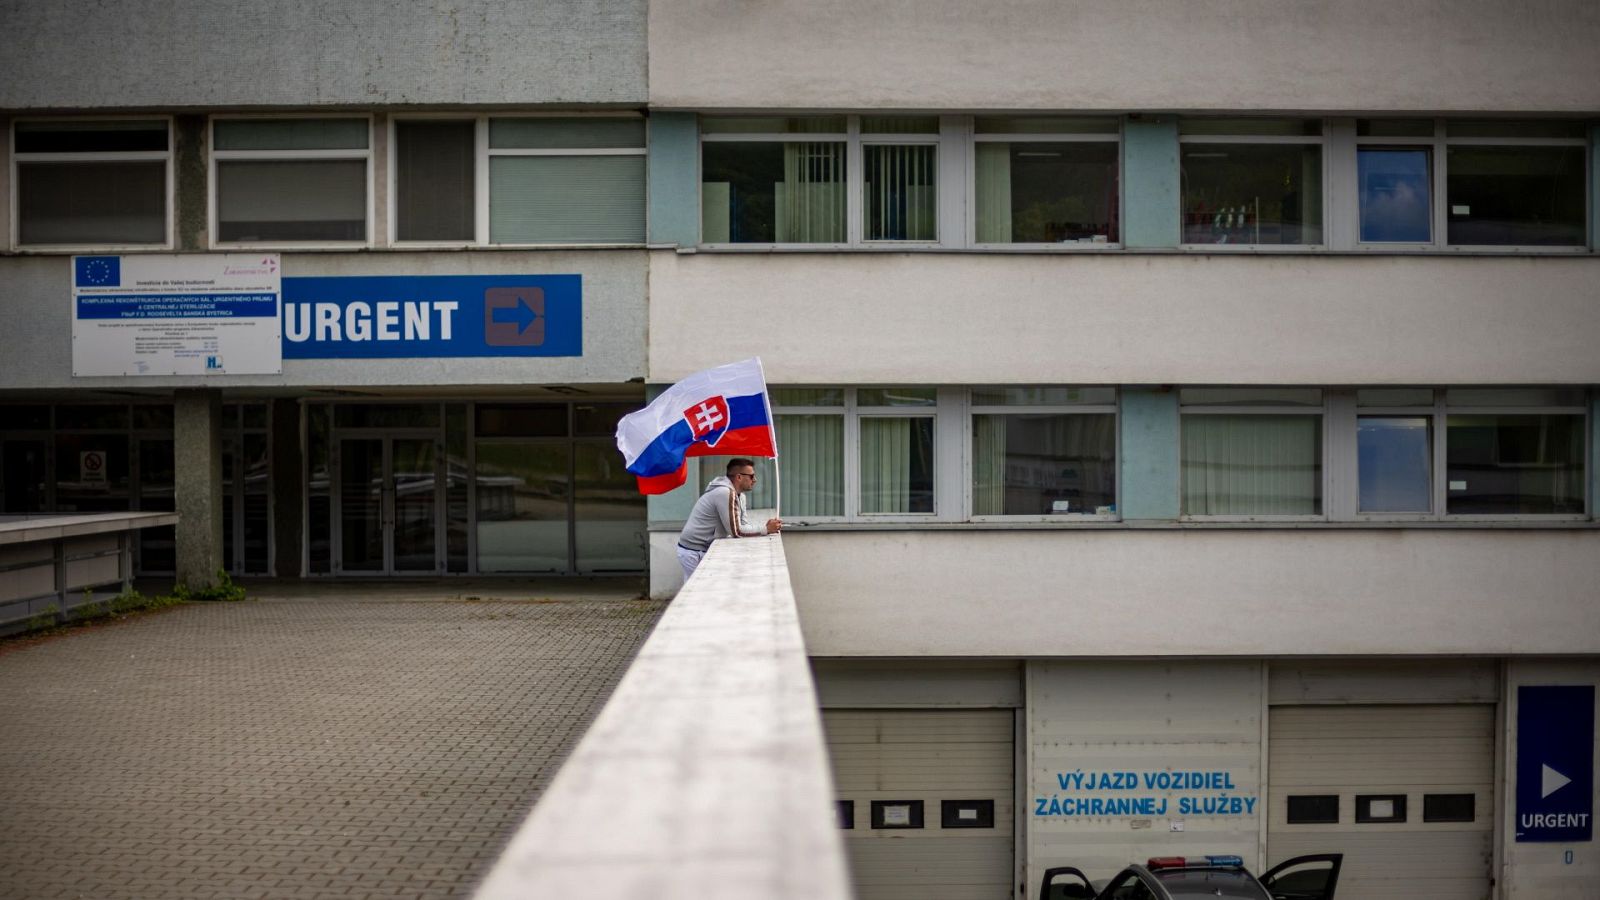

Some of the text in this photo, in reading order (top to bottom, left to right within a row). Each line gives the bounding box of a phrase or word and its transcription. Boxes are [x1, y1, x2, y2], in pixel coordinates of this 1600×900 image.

[284, 301, 459, 342] URGENT
[1057, 768, 1235, 790] VÝJAZD VOZIDIEL
[1035, 793, 1257, 816] ZÁCHRANNEJ SLUŽBY
[1521, 813, 1589, 828] URGENT
